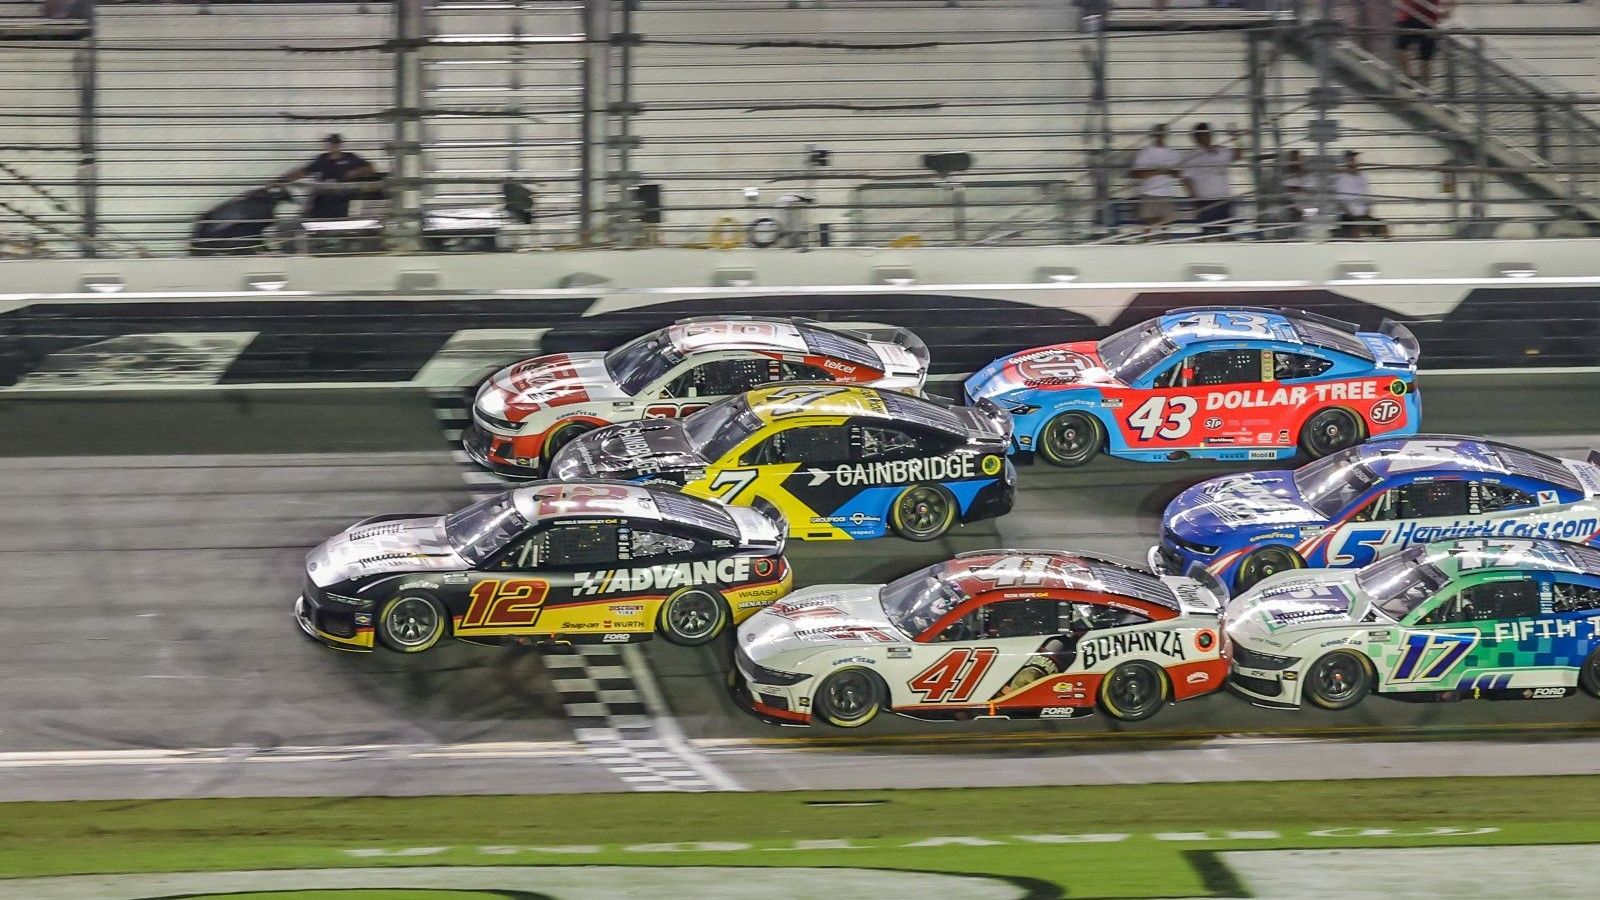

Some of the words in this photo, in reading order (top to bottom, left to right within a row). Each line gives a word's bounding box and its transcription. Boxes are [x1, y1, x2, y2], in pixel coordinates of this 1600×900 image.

[824, 360, 856, 374] telcel
[1206, 386, 1307, 411] DOLLAR
[1313, 381, 1377, 401] TREE
[1127, 395, 1199, 442] 43
[1205, 418, 1222, 431] STP
[1373, 402, 1400, 422] STP
[836, 455, 976, 486] GAINBRIDGE
[709, 469, 758, 506] 7
[1327, 529, 1393, 567] 5
[605, 557, 750, 594] ADVANCE
[458, 577, 549, 630] 12
[738, 589, 778, 598] WABASH
[560, 621, 600, 629] Snap-on
[1495, 618, 1576, 643] FIFTH
[1083, 631, 1186, 669] BONANZA
[1391, 629, 1481, 684] 17
[908, 647, 999, 704] 41
[1534, 687, 1566, 695] FORD
[1041, 707, 1074, 716] FORD
[339, 831, 1281, 857] DAYTONA
